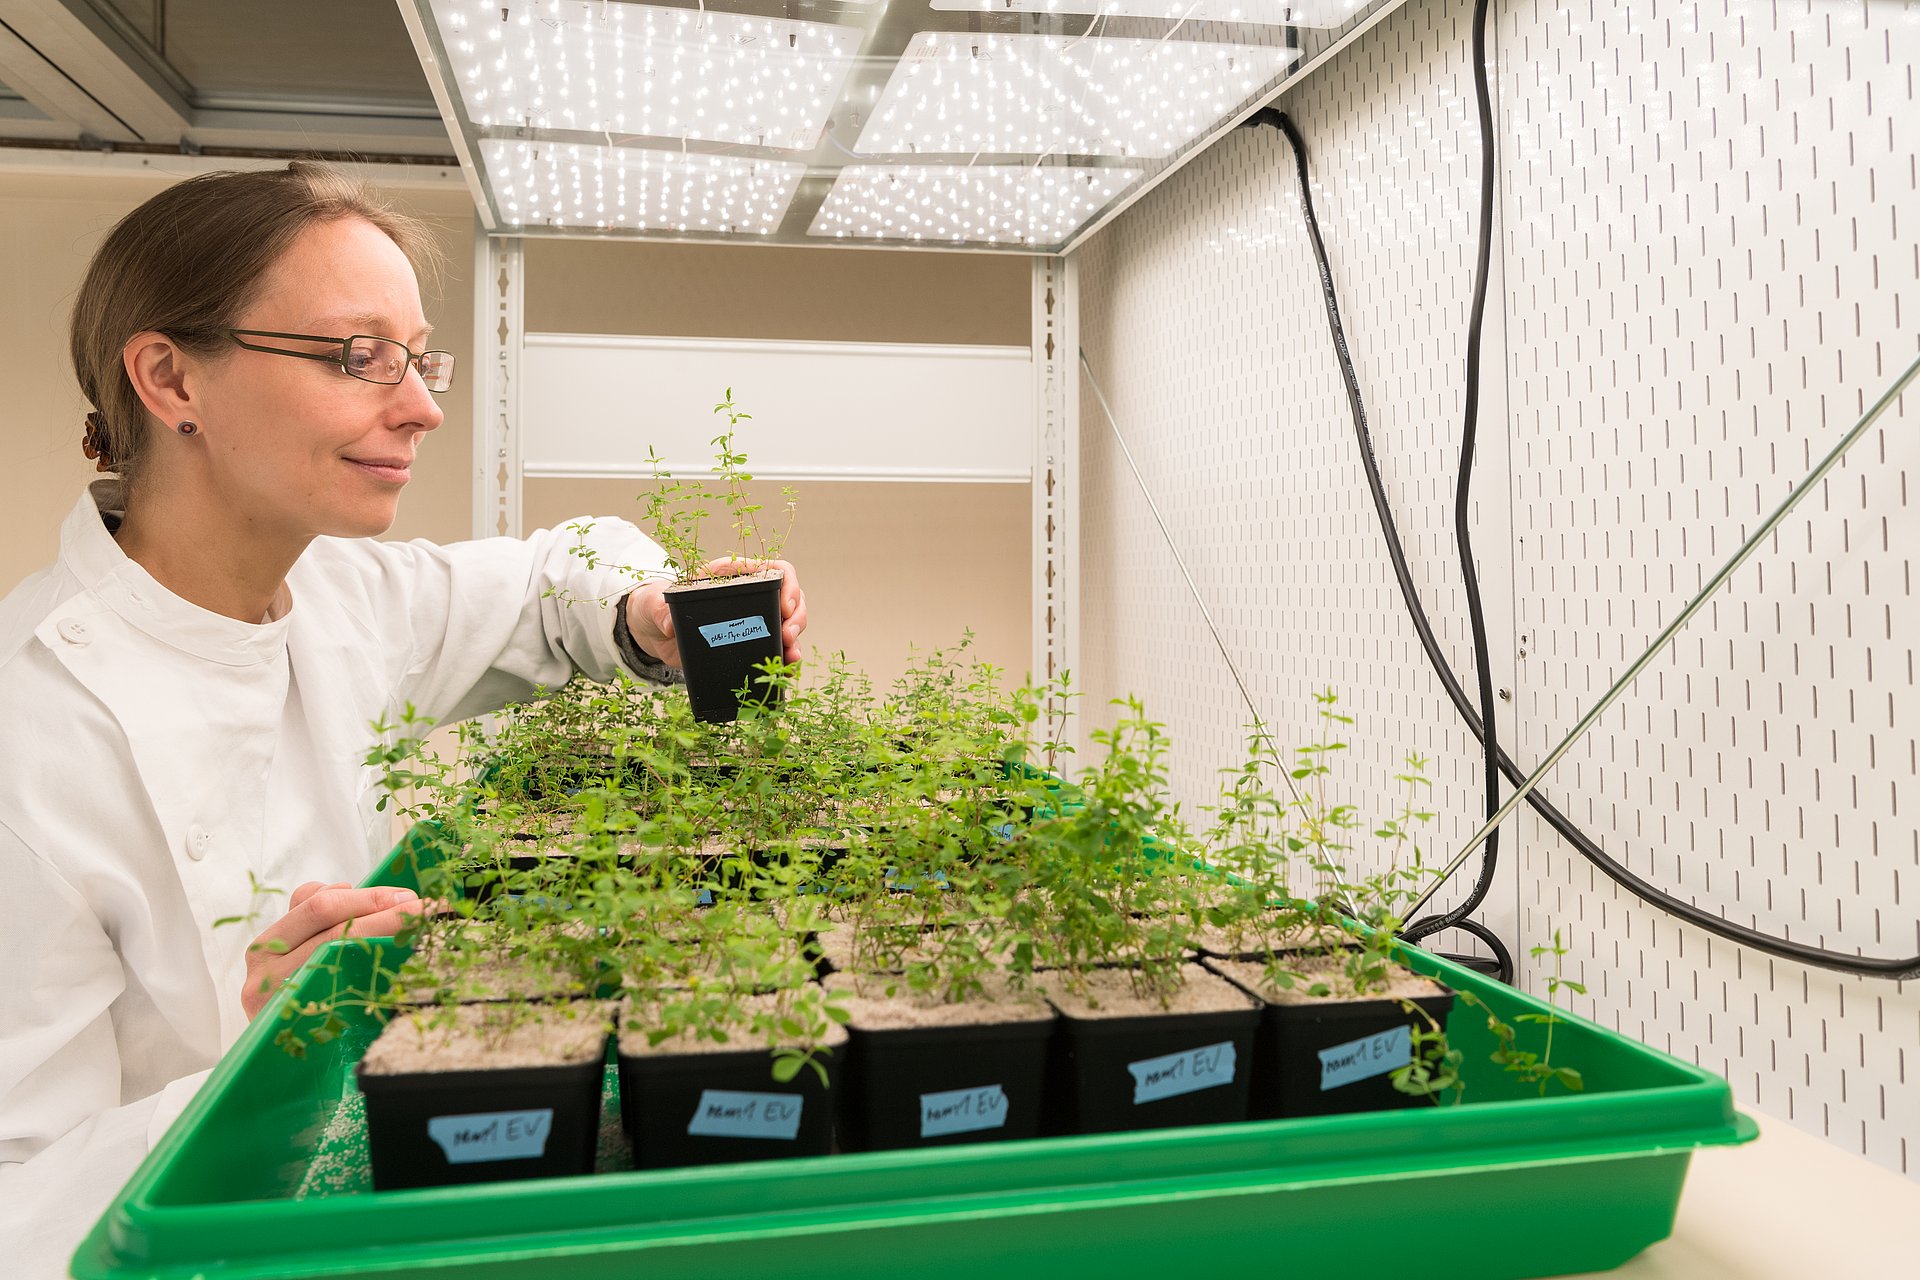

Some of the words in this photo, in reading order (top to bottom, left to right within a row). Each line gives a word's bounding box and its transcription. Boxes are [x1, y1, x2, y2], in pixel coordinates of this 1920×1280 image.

[1372, 1032, 1400, 1060] EV
[1192, 1046, 1222, 1077] EV
[763, 1101, 796, 1122] EV
[977, 1090, 1002, 1115] EV
[506, 1115, 545, 1141] EV
